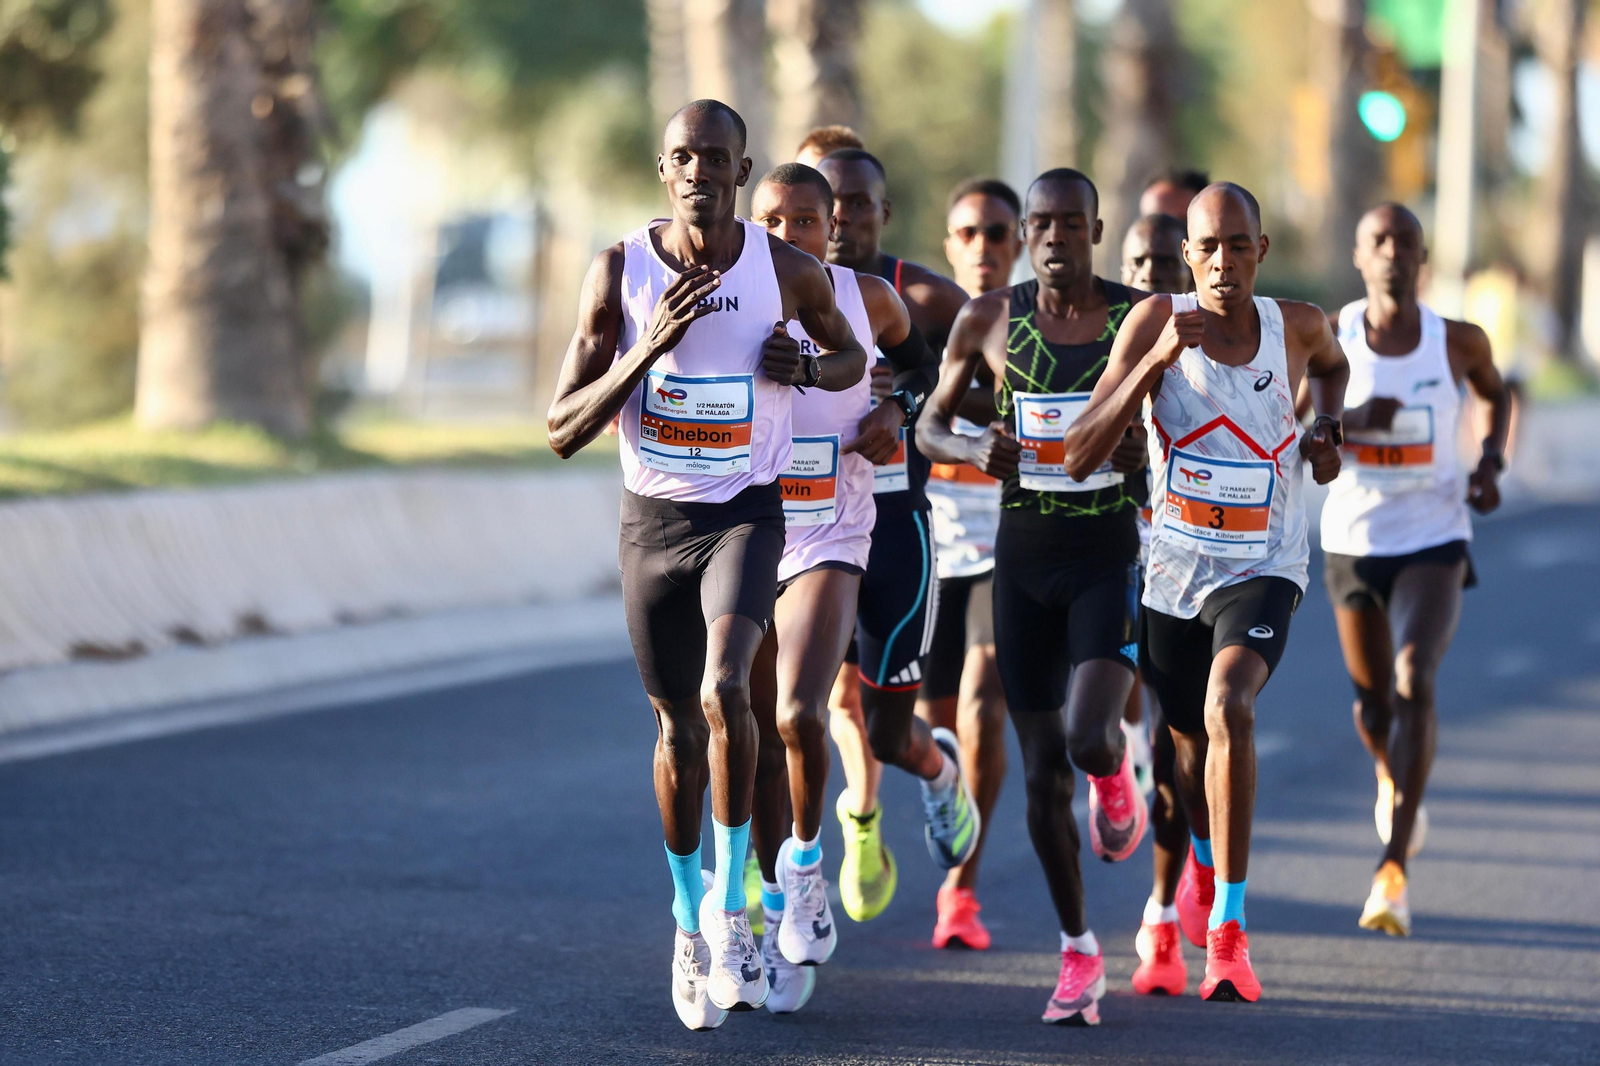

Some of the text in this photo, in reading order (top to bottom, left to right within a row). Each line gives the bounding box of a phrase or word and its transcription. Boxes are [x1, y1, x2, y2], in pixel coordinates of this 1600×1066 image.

[697, 296, 738, 312] RUN
[653, 403, 688, 415] TotalEnergies
[661, 425, 732, 443] Chebon
[688, 447, 702, 457] 12
[1376, 447, 1403, 468] 10
[686, 462, 711, 470] málaga
[1229, 485, 1256, 493] MARATÓN
[1208, 506, 1225, 529] 3
[1183, 524, 1245, 539] Boniface Kibiwott
